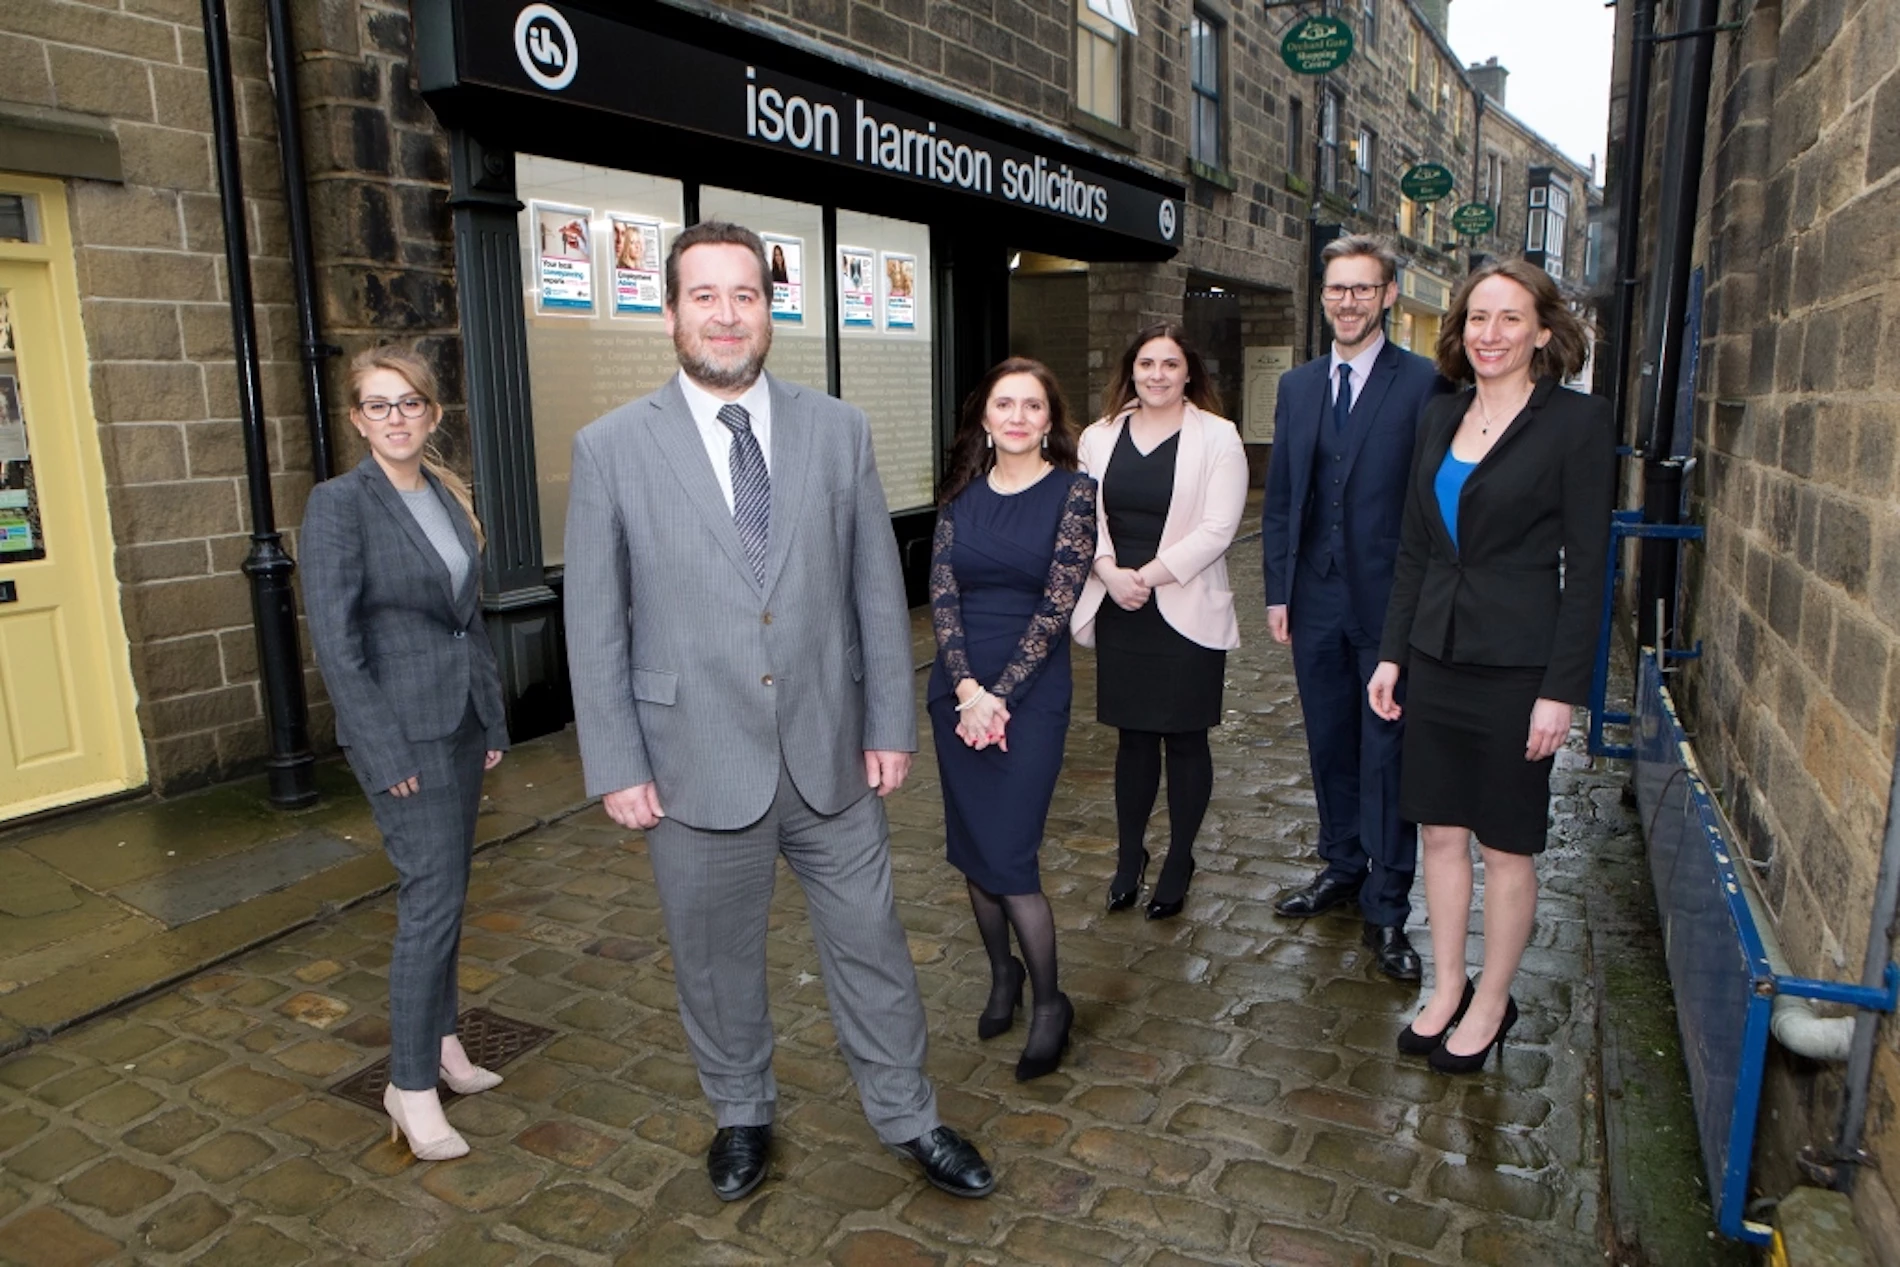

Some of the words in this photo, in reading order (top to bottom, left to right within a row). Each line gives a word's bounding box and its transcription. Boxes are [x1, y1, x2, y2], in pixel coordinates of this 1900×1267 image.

[1287, 39, 1324, 52] Orchard
[1326, 38, 1348, 48] Gate
[1296, 50, 1338, 62] Shopping
[1302, 60, 1331, 69] Centre
[746, 65, 839, 155] ison
[856, 99, 992, 194] harrison
[1002, 155, 1107, 222] solicitors
